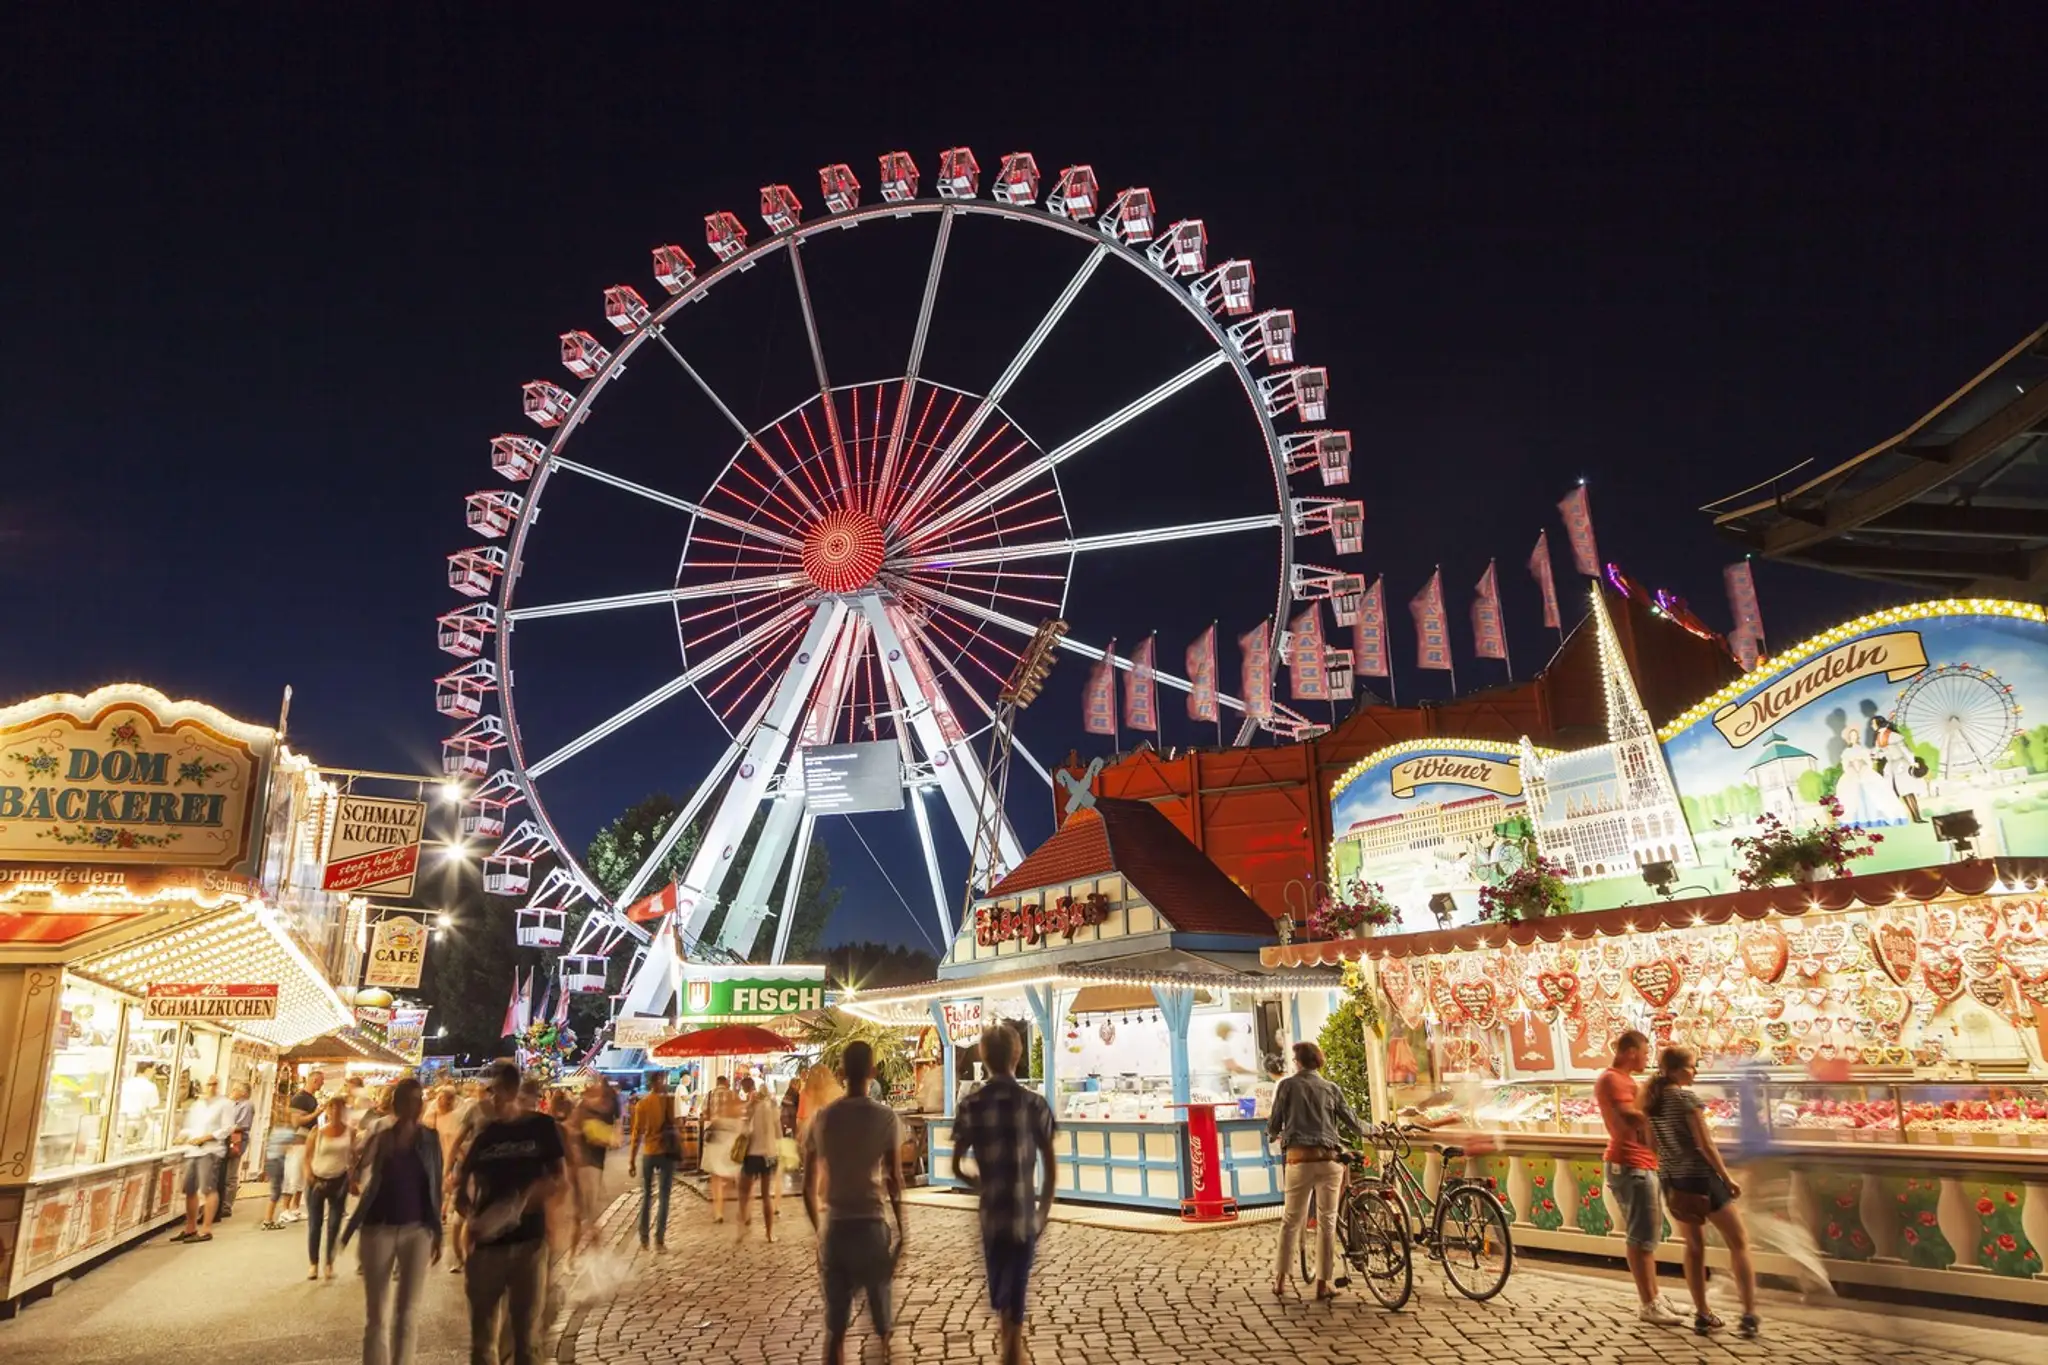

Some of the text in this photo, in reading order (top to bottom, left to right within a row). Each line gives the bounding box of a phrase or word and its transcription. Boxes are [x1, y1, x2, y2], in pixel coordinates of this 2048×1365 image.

[1734, 640, 1888, 737] Mandeln
[65, 748, 172, 786] DOM
[1402, 757, 1493, 782] Wiener
[0, 785, 227, 827] BÄCKEREI
[341, 803, 417, 827] SCHMALZ
[342, 823, 411, 846] KUCHEN
[338, 848, 407, 877] stets heiß
[329, 871, 360, 889] und
[375, 948, 420, 964] CAFÉ
[148, 998, 273, 1017] SCHMALZKUCHEN
[733, 987, 821, 1012] FISCH
[944, 1003, 980, 1024] Fish &
[949, 1022, 980, 1043] Chips
